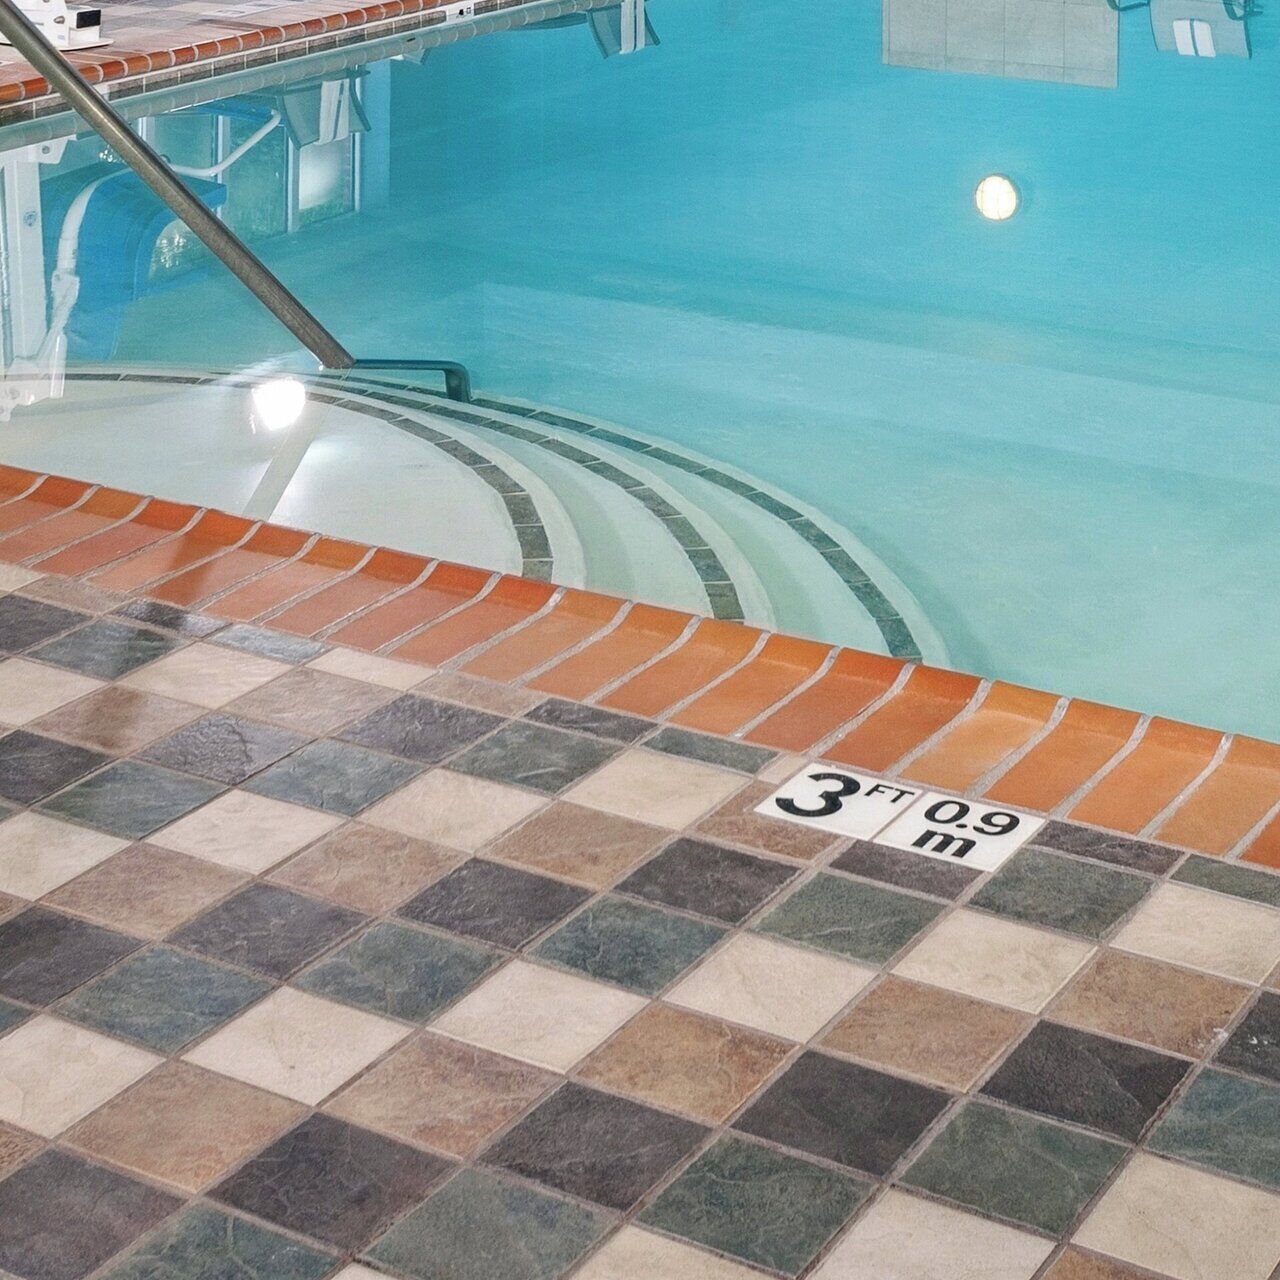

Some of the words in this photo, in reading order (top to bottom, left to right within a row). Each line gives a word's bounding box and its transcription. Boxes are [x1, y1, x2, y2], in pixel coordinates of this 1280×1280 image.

[775, 772, 861, 818] 3
[864, 783, 916, 804] FT
[924, 800, 1020, 836] 0.9
[911, 829, 977, 859] m
